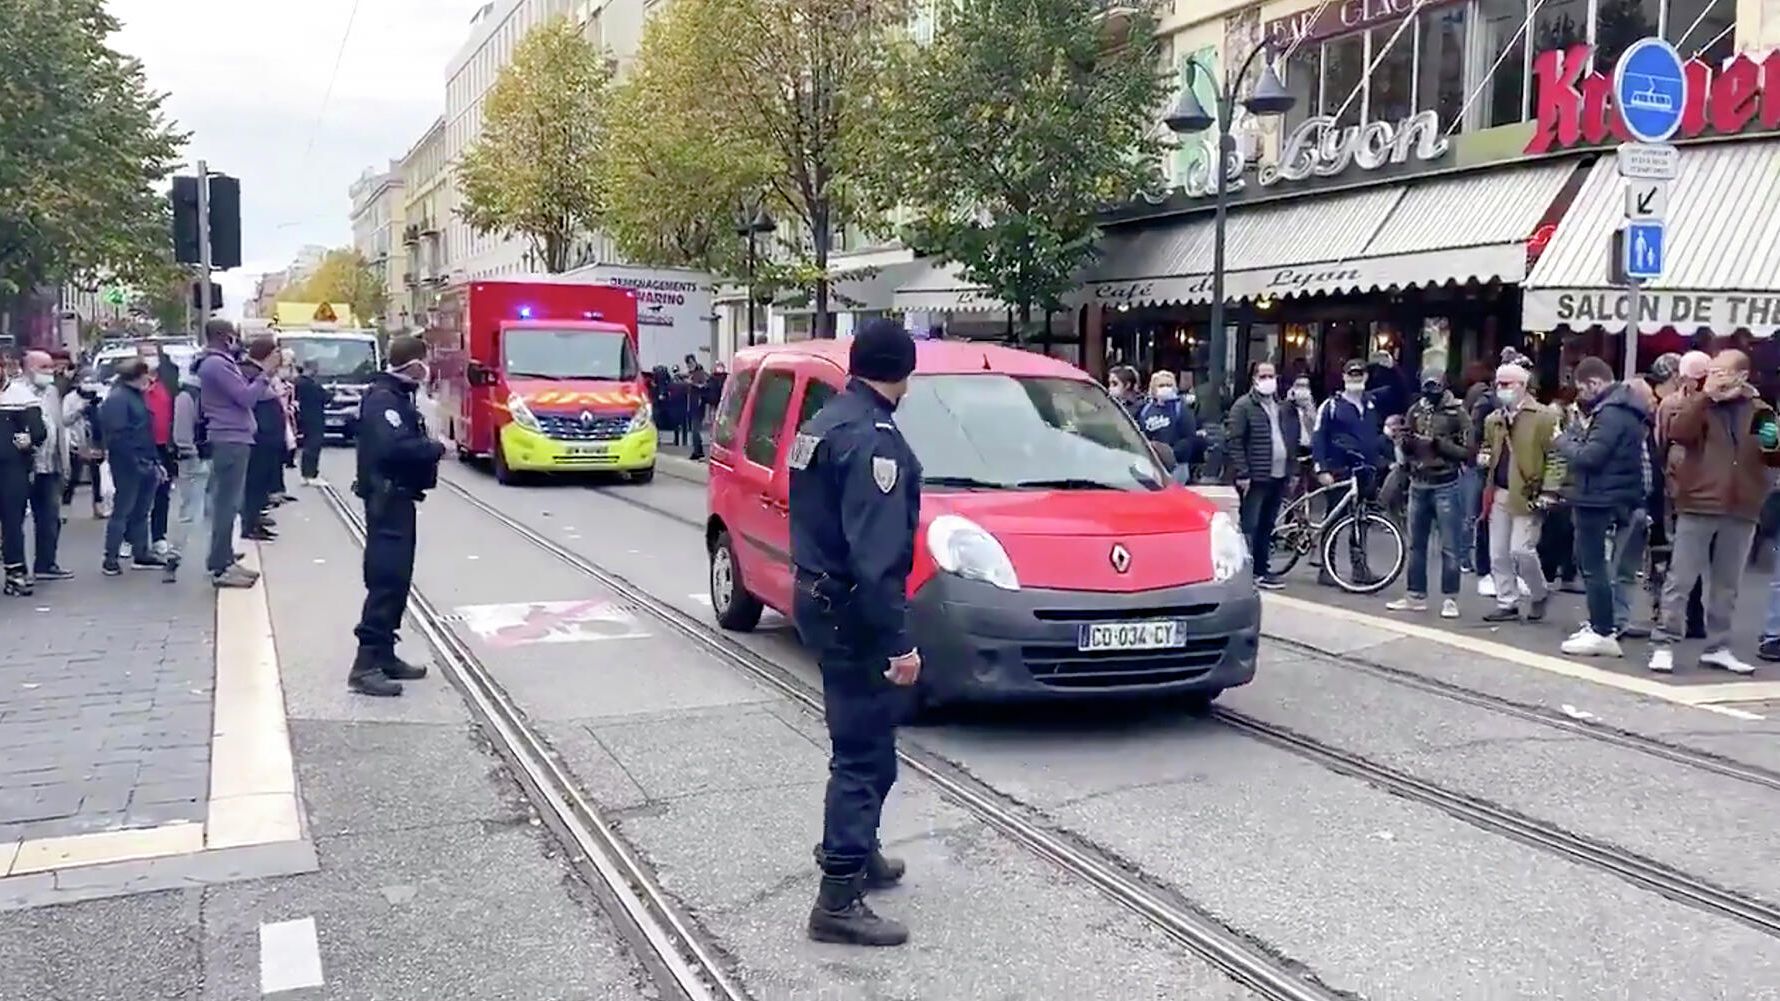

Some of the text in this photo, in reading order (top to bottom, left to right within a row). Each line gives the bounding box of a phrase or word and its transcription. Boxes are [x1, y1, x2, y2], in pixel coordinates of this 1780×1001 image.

[1259, 110, 1448, 186] Lyon
[1095, 283, 1154, 299] Café
[1266, 269, 1362, 289] Lyon
[1557, 294, 1660, 321] SALON
[1670, 296, 1714, 322] DE
